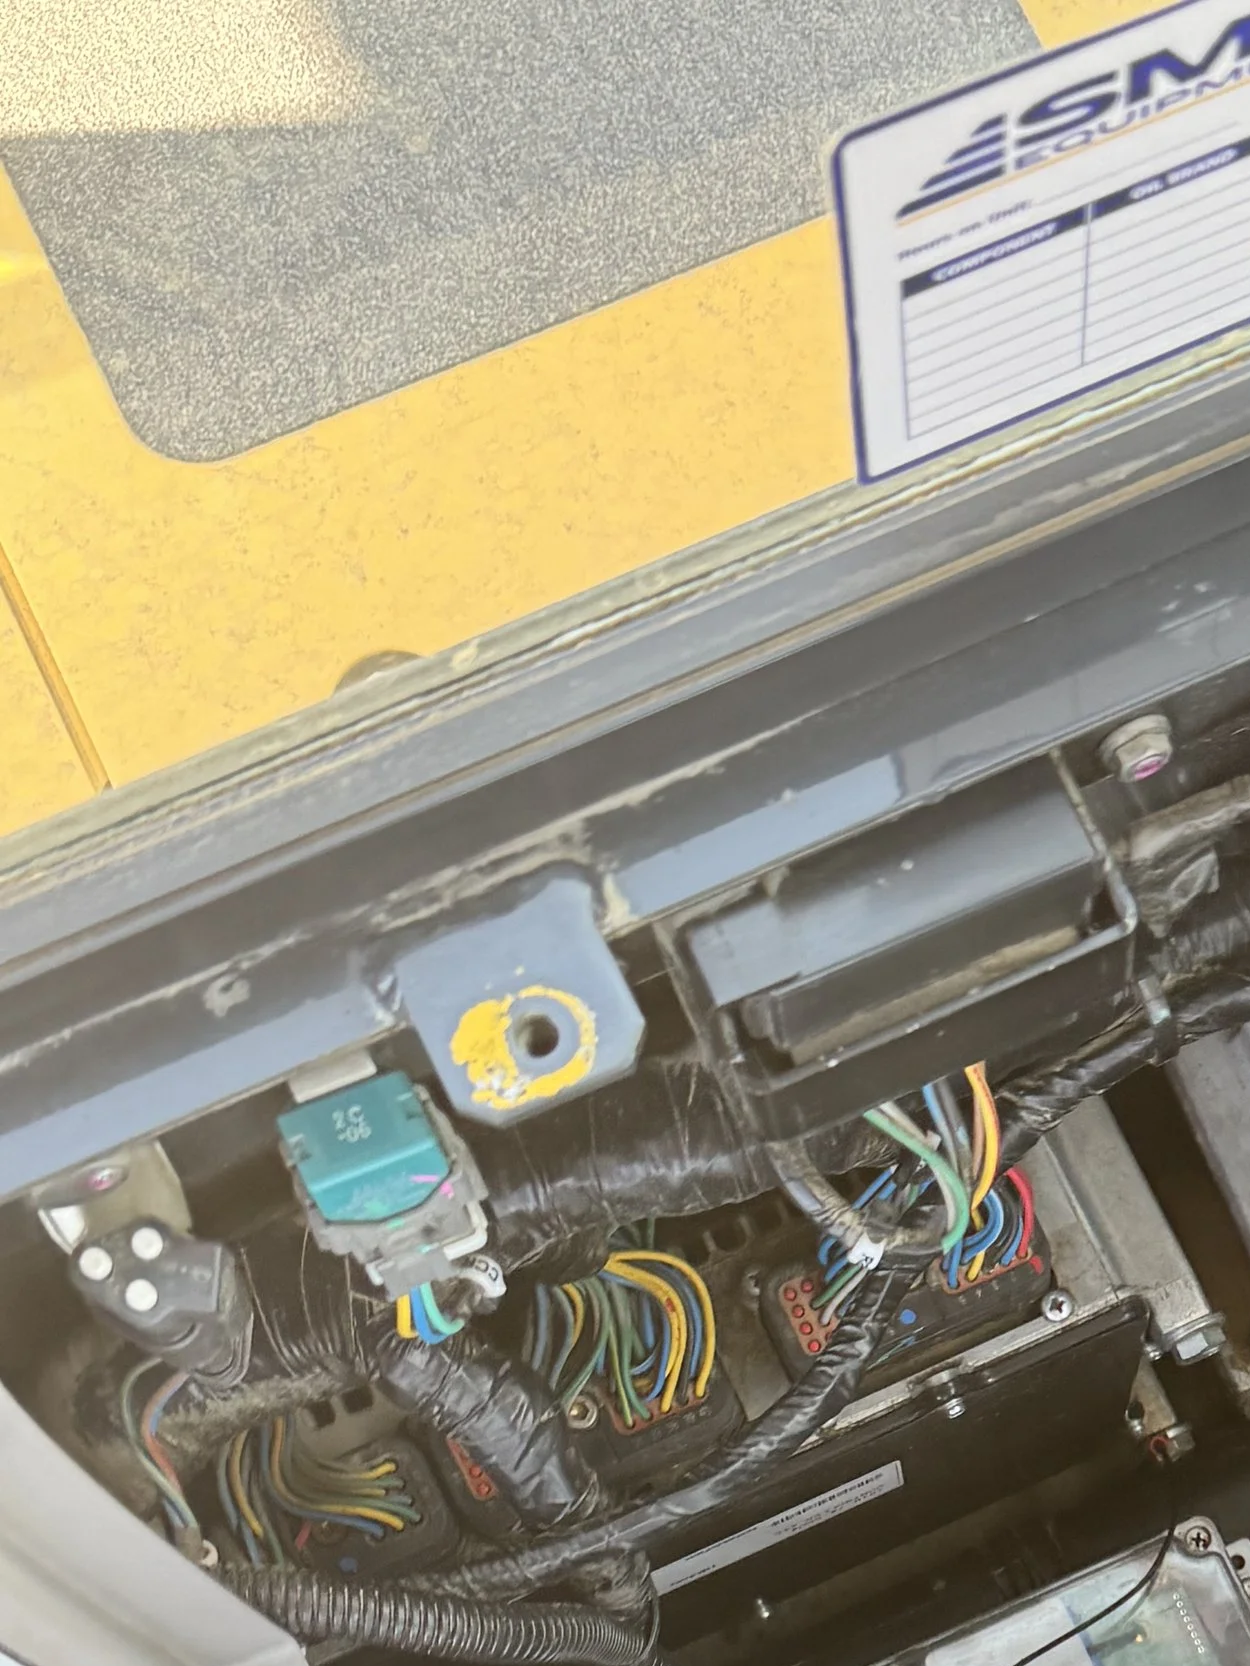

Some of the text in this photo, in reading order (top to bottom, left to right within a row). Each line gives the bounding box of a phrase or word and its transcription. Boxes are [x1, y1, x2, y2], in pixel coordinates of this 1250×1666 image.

[1128, 147, 1240, 201] OIL BRAND
[929, 221, 1059, 283] COMPONENT
